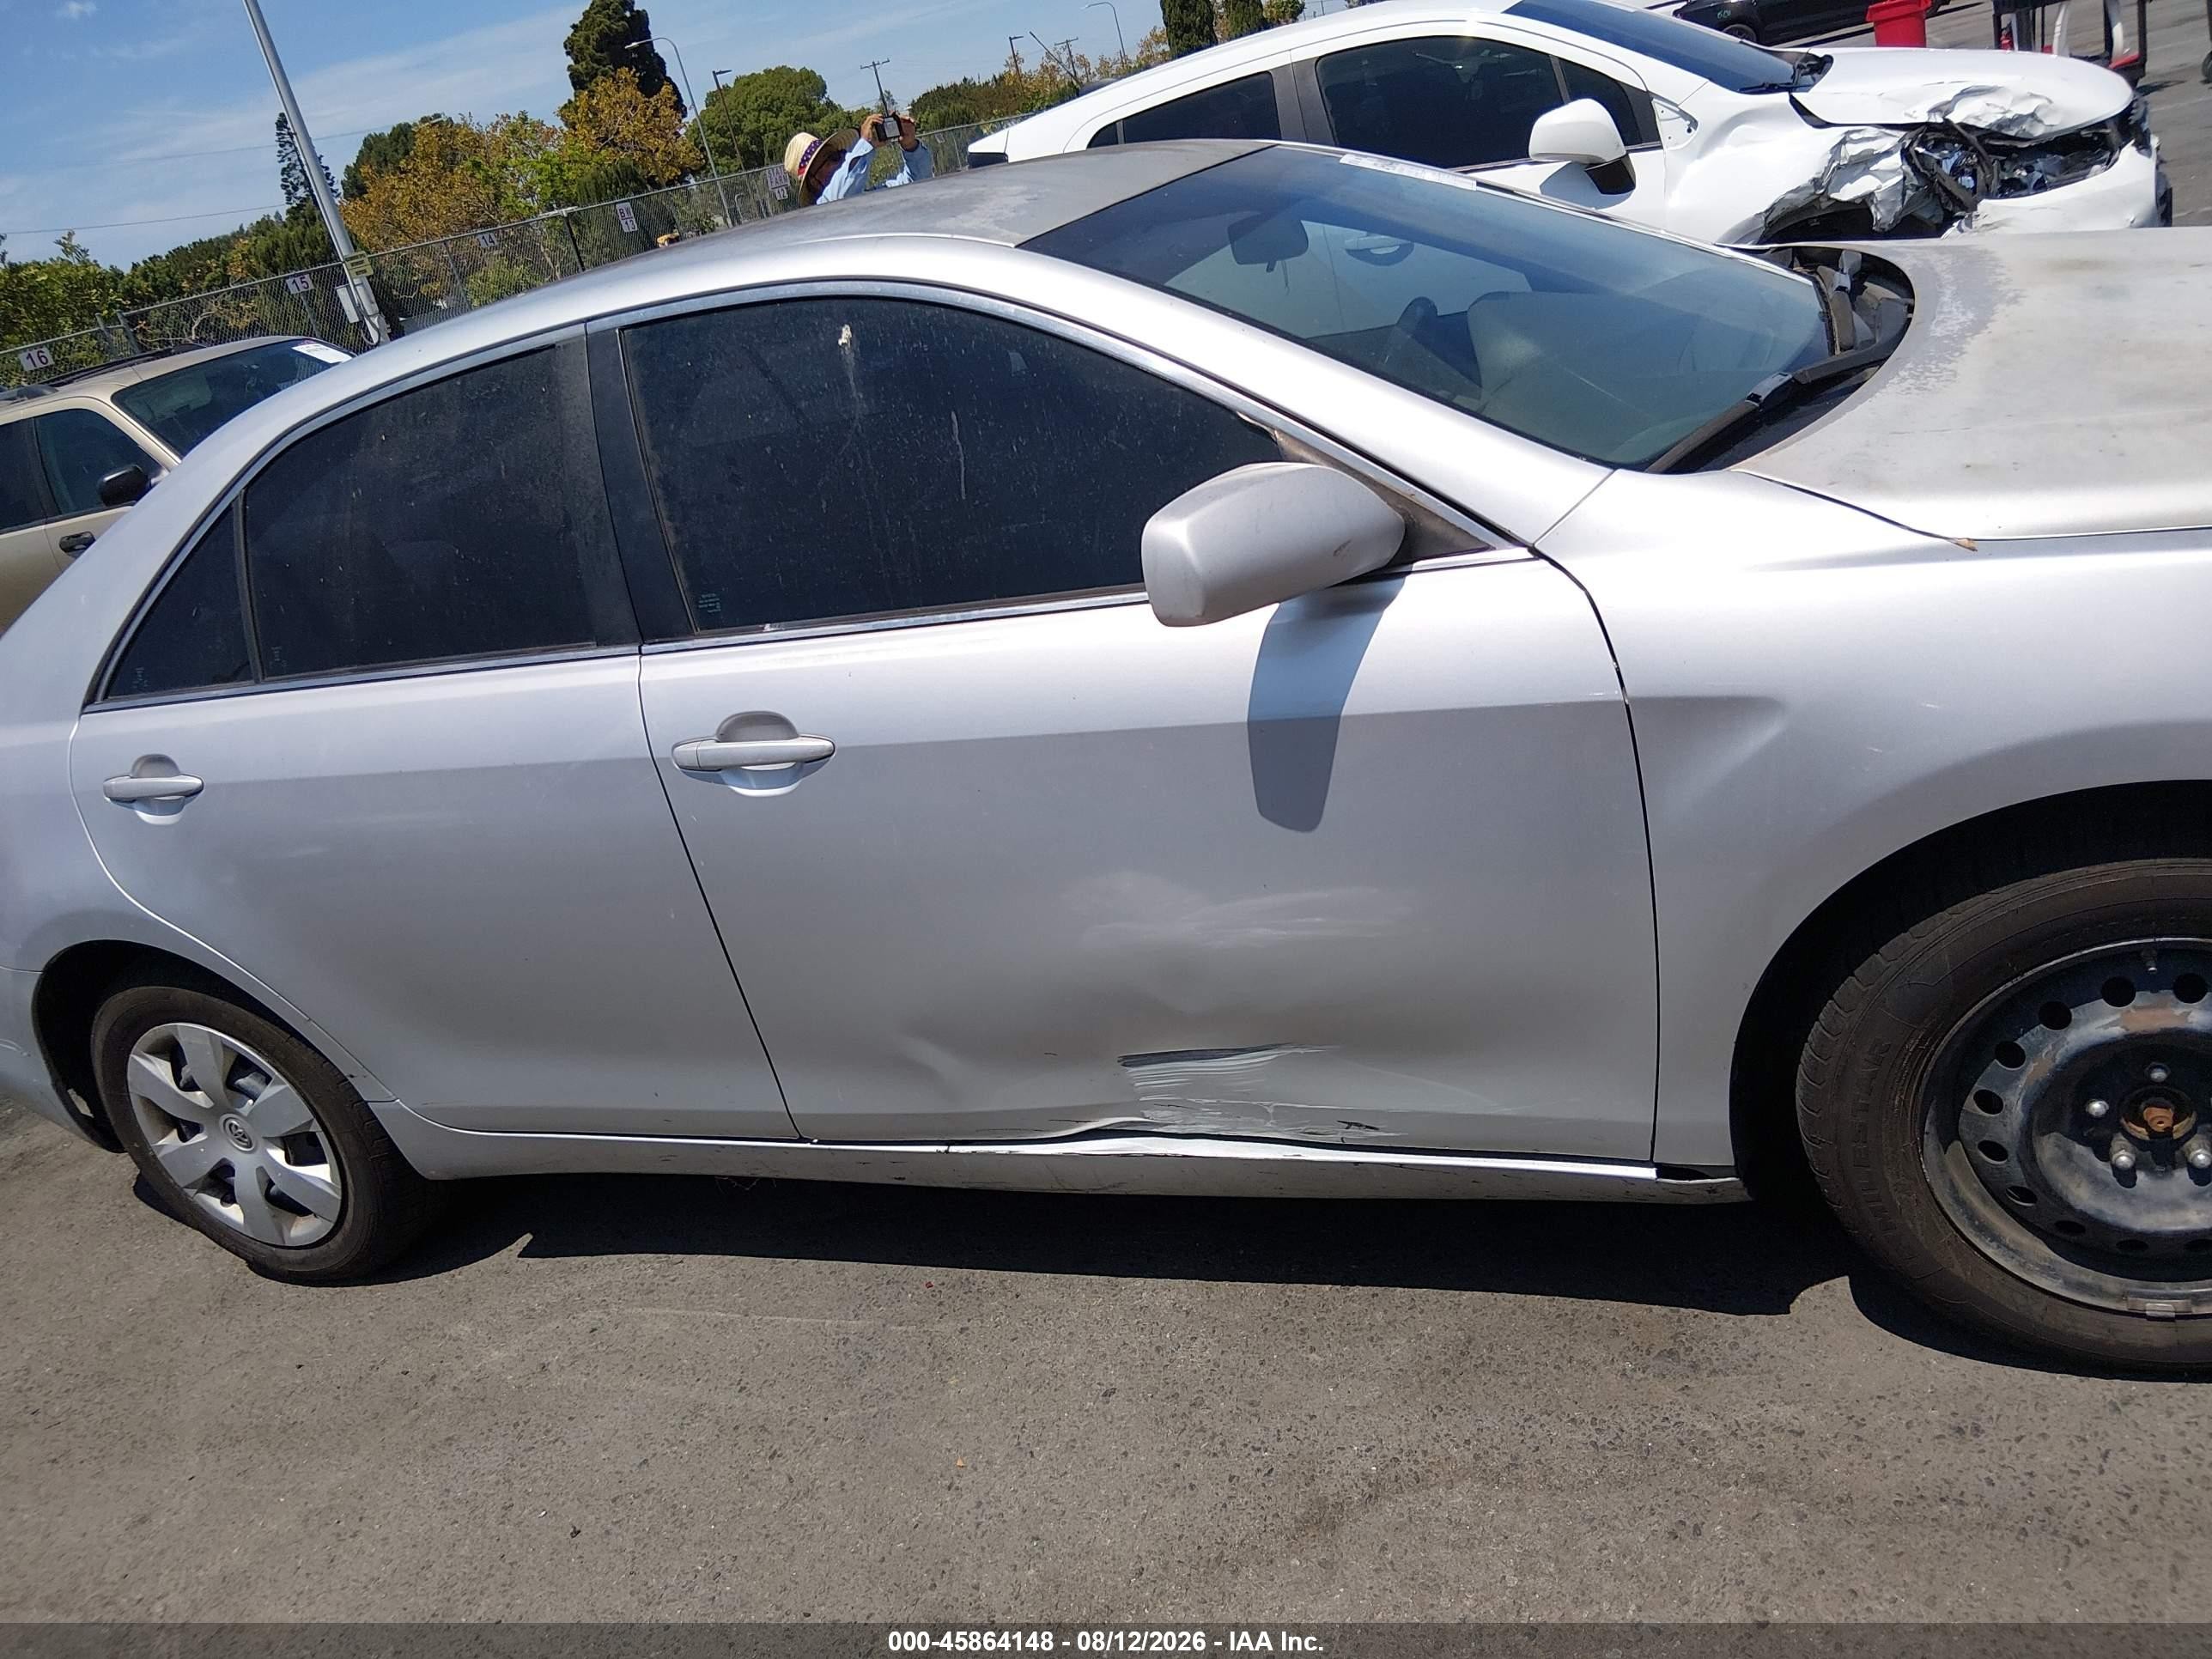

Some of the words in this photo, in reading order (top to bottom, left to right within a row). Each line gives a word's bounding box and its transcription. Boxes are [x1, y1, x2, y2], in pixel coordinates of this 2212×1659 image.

[777, 188, 787, 198] 12
[618, 206, 632, 218] BW
[625, 219, 635, 231] 13
[481, 234, 495, 246] 14
[292, 276, 309, 291] 15
[26, 349, 49, 368] 16
